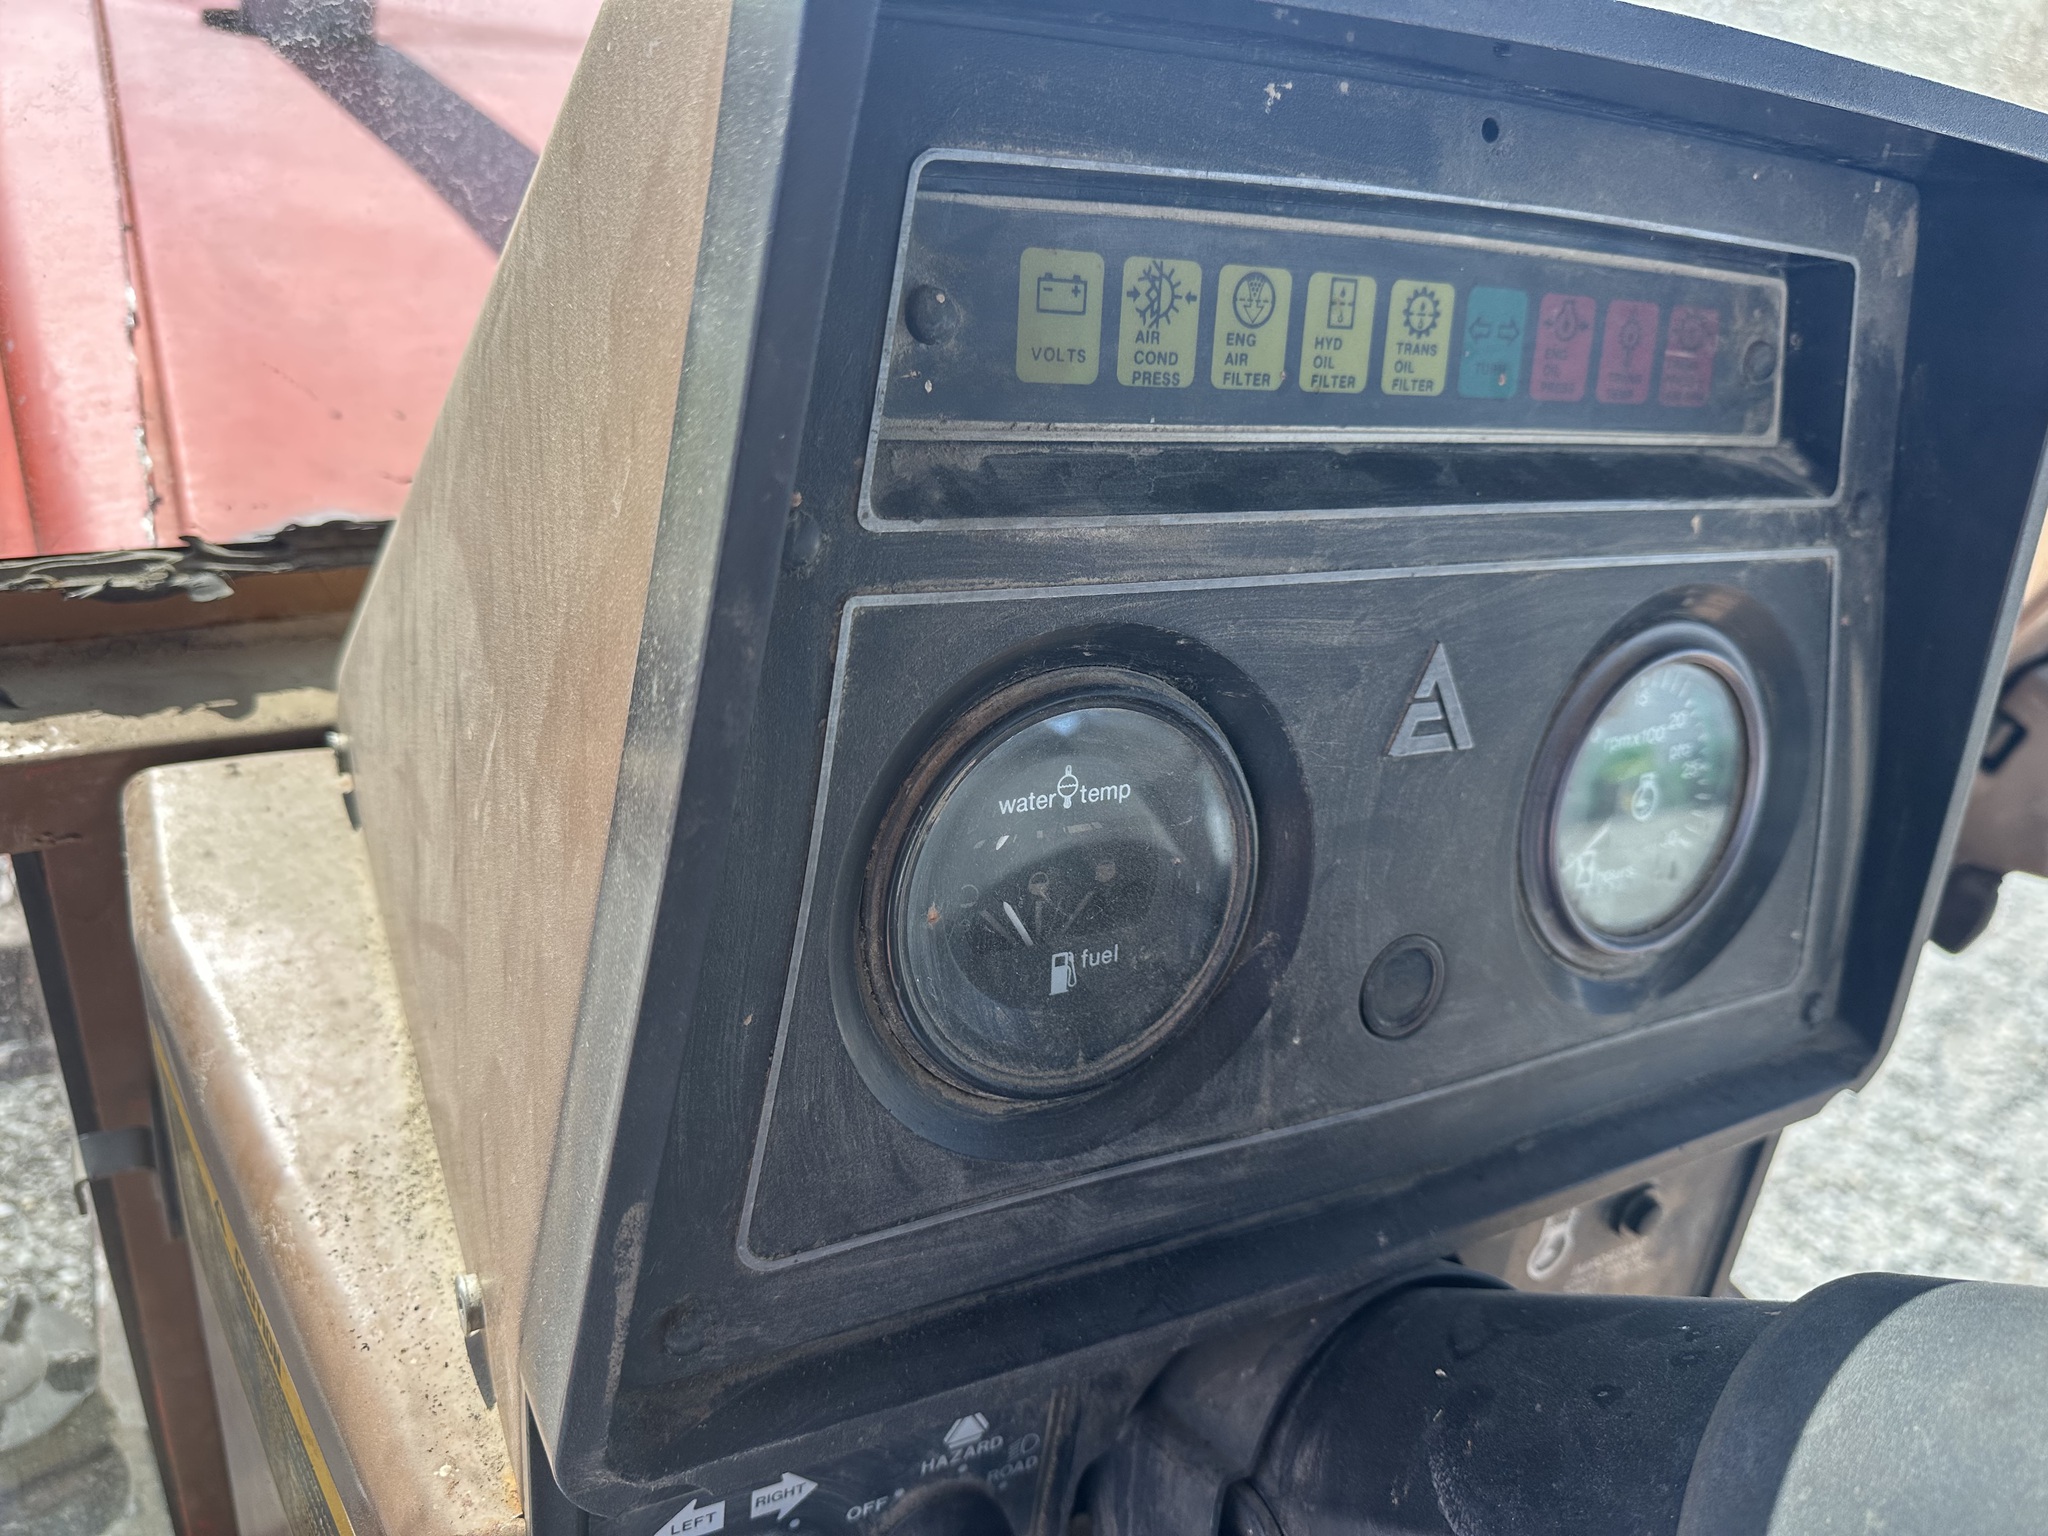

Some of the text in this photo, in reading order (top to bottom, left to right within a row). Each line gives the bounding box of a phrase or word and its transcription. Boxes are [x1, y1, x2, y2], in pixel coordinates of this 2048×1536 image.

[1135, 330, 1160, 345] AIR
[1225, 333, 1257, 347] ENG
[1314, 337, 1343, 351] HYD
[1031, 347, 1086, 363] VOLTS
[1396, 342, 1438, 357] TRANS
[1133, 350, 1179, 366] COND
[1224, 352, 1248, 366] AIR
[1313, 356, 1334, 369] OIL
[1394, 360, 1414, 374] OIL
[1131, 371, 1181, 387] PRESS
[1222, 372, 1270, 387] FILTER
[1310, 374, 1356, 389] FILTER
[1391, 379, 1434, 392] FILTER
[998, 782, 1131, 815] water temp
[1081, 945, 1119, 969] fuel
[921, 1434, 1004, 1477] HAZARD
[987, 1454, 1039, 1482] ROAD
[755, 1482, 807, 1508] RIGHT
[846, 1495, 889, 1521] OFF
[671, 1511, 717, 1536] LEFT
